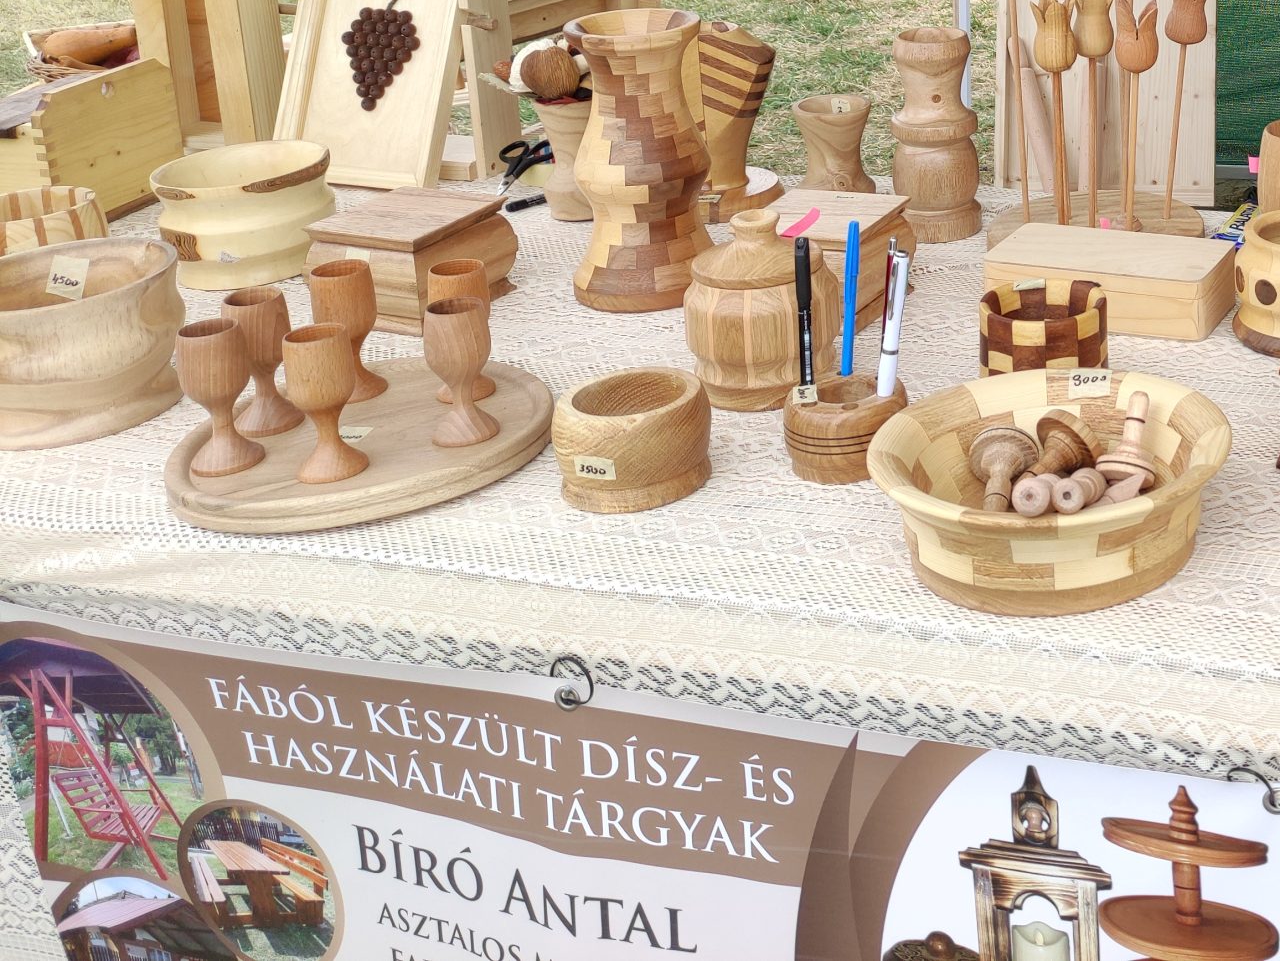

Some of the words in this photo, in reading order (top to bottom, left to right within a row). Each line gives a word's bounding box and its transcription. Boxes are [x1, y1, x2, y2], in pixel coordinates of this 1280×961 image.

[52, 273, 79, 287] 4500
[579, 463, 607, 475] 3500
[205, 675, 353, 729] FÁBÓL
[361, 698, 562, 772] KÉSZÜLT
[578, 735, 722, 792] DÍSZ-
[740, 754, 795, 805] ÉS
[241, 731, 525, 820] HASZNÁLATI
[536, 788, 780, 864] TÁRGYAK
[351, 824, 484, 901] BÍRÓ
[498, 868, 698, 954] ANTAL
[377, 902, 521, 961] ASZTALOS
